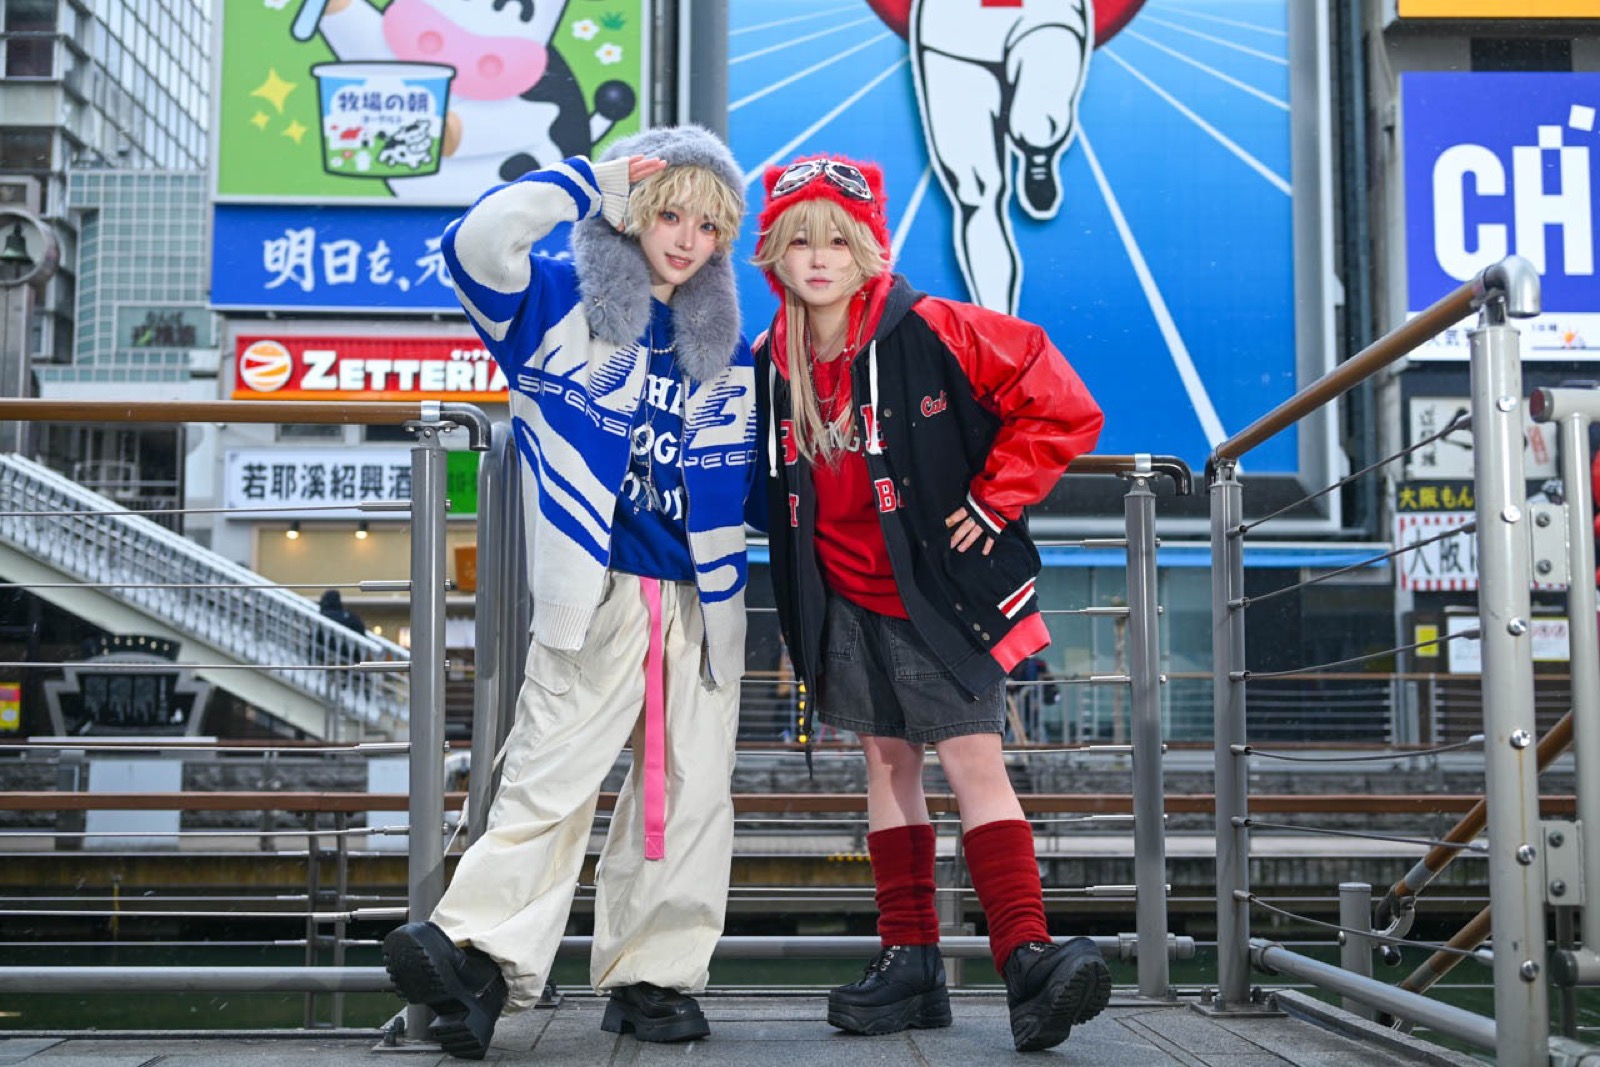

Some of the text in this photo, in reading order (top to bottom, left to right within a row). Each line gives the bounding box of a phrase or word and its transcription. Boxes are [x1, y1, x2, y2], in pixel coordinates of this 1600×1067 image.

[338, 92, 429, 112] 牧場の朝
[1408, 526, 1475, 575] 大阪
